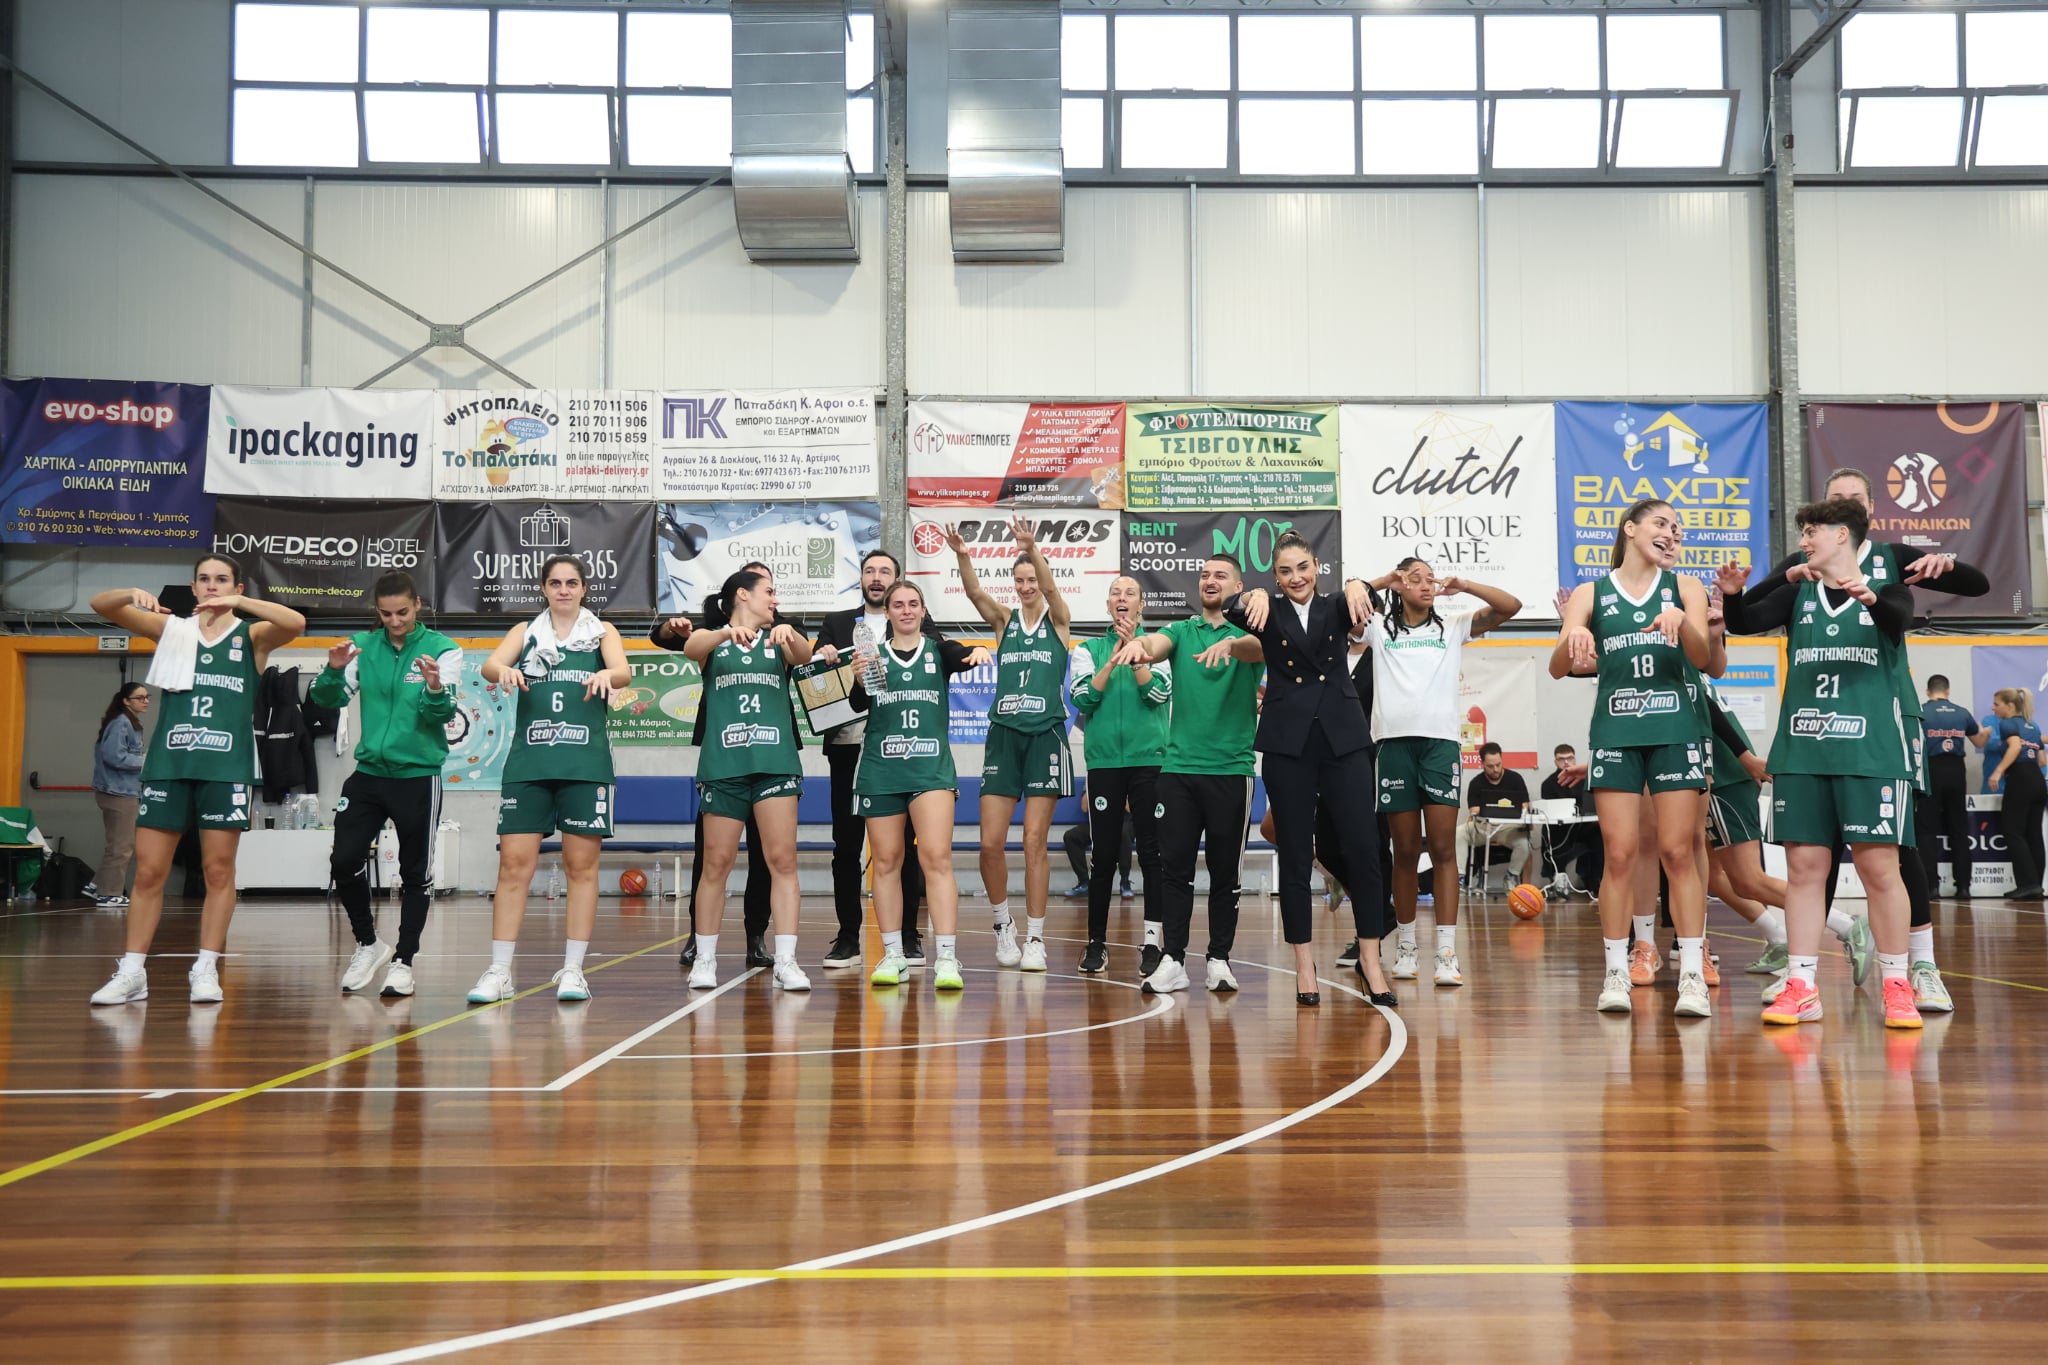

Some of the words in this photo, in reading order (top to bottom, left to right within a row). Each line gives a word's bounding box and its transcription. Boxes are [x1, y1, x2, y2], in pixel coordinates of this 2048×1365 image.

[569, 400, 590, 411] 210
[593, 400, 608, 411] 70
[610, 400, 622, 411] 11
[625, 400, 648, 411] 506
[734, 397, 797, 411] Παπαδάκη
[800, 398, 811, 410] Κ.
[814, 399, 844, 411] Αφοι
[847, 399, 869, 408] ο.ε.
[45, 401, 173, 428] evo-shop
[443, 397, 560, 427] ΨΗΤΟΠΩΛΕΙΟ
[662, 397, 728, 439] ΠΚ
[569, 416, 590, 427] 210
[593, 416, 608, 427] 70
[610, 416, 622, 427] 11
[625, 416, 648, 427] 906
[735, 417, 773, 426] ΕΜΠΟΡΙΟ
[775, 416, 810, 425] ΣΙΔΗΡΟΥ
[816, 415, 867, 424] ΑΛΟΥΜΙΝΙΟΥ
[1150, 412, 1313, 432] ΦΡΟΥΤΕΜΠΟΡΙΚΗ
[569, 432, 590, 443] 210
[593, 432, 608, 443] 70
[610, 432, 622, 443] 15
[625, 432, 648, 443] 859
[777, 427, 840, 437] ΕΞΑΡΤΗΜΑΤΩΝ
[226, 416, 418, 468] ipackaging
[946, 434, 1011, 446] ΥΛΙΚΟΕΠΙΛΟΓΕΣ
[1160, 437, 1302, 454] ΤΣΙΒΓΟΥΛΗΣ
[442, 451, 466, 467] Το
[472, 449, 557, 468] Παλατάκι
[579, 451, 595, 461] line
[663, 455, 696, 466] Αγραίων
[699, 455, 709, 464] 26
[711, 455, 717, 464] &
[719, 454, 761, 465] Διοκλέους,
[764, 454, 777, 463] 116
[780, 454, 788, 463] 32
[806, 454, 840, 464] Αρτέμιος
[1025, 457, 1067, 465] ΝΕΡΟΧΥΤΕΣ
[1139, 457, 1185, 469] εμπόριο
[1189, 456, 1241, 469] Φρούτων
[1246, 457, 1255, 467] &
[1260, 456, 1324, 467] Λαχανικών
[24, 456, 76, 470] ΧΑΡΤΙΚΑ
[88, 459, 187, 475] ΑΠΟΡΡΥΠΑΝΤΙΚΑ
[566, 466, 649, 477] palataki-delivery.gr
[684, 469, 697, 477] 210
[699, 469, 709, 477] 76
[709, 469, 718, 477] 20
[719, 469, 732, 477] 732
[754, 468, 772, 476] 6977
[825, 466, 838, 475] 210
[838, 466, 848, 475] 76
[858, 465, 870, 474] 373
[1372, 435, 1523, 499] clutch
[62, 476, 114, 491] ΟΙΚΙΑΚΑ
[119, 478, 150, 492] ΕΙΔΗ
[486, 484, 539, 494] ΑΜΦΙΚΡΑΤΟΥΣ
[569, 485, 607, 494] ΑΡΤΕΜΙΟΣ
[663, 482, 719, 492] Υποκατάστημα
[760, 481, 783, 490] 22990
[786, 481, 796, 490] 67
[917, 489, 990, 498] www.ylikoepiloges.gr
[18, 507, 33, 518] Χρ.
[35, 508, 76, 520] Σμύρνης
[79, 510, 85, 518] &
[88, 510, 136, 522] Περγάμου
[17, 523, 36, 533] 210
[38, 523, 50, 532] 76
[51, 524, 64, 533] 20
[66, 524, 84, 534] 230
[93, 525, 116, 534] Web:
[118, 527, 199, 539] www.evo-shop.gr
[1130, 522, 1177, 536] RENT
[1382, 516, 1522, 541] BOUTIQUE
[1890, 518, 1970, 530] ΓΥΝΑΙΚΩΝ
[1576, 530, 1613, 540] ΚΑΜΕΡΑ
[1697, 532, 1749, 542] ΑΝΤΛΗΣΕΙΣ
[213, 533, 358, 556] HOMEDECO
[366, 537, 425, 553] HOTEL
[727, 541, 802, 561] Graphic
[1130, 542, 1176, 554] MOTO
[283, 557, 308, 567] design
[309, 557, 330, 566] made
[331, 557, 356, 567] simple
[366, 552, 418, 568] DECO
[268, 585, 364, 597] www.home-deco.gr
[590, 583, 606, 591] all
[1795, 647, 1878, 666] PANATHINAIKOS
[1631, 654, 1654, 678] 18
[715, 672, 780, 691] PANATHINAIKOS
[1815, 674, 1839, 698] 21
[552, 691, 564, 712] 6
[738, 694, 761, 714] 24
[876, 690, 940, 707] PANATHINAIKOS
[191, 696, 213, 718] 12
[612, 719, 622, 727] 26
[629, 719, 638, 727] Ν.
[640, 718, 671, 728] Κόσμος
[901, 709, 919, 729] 16
[659, 730, 675, 738] email:
